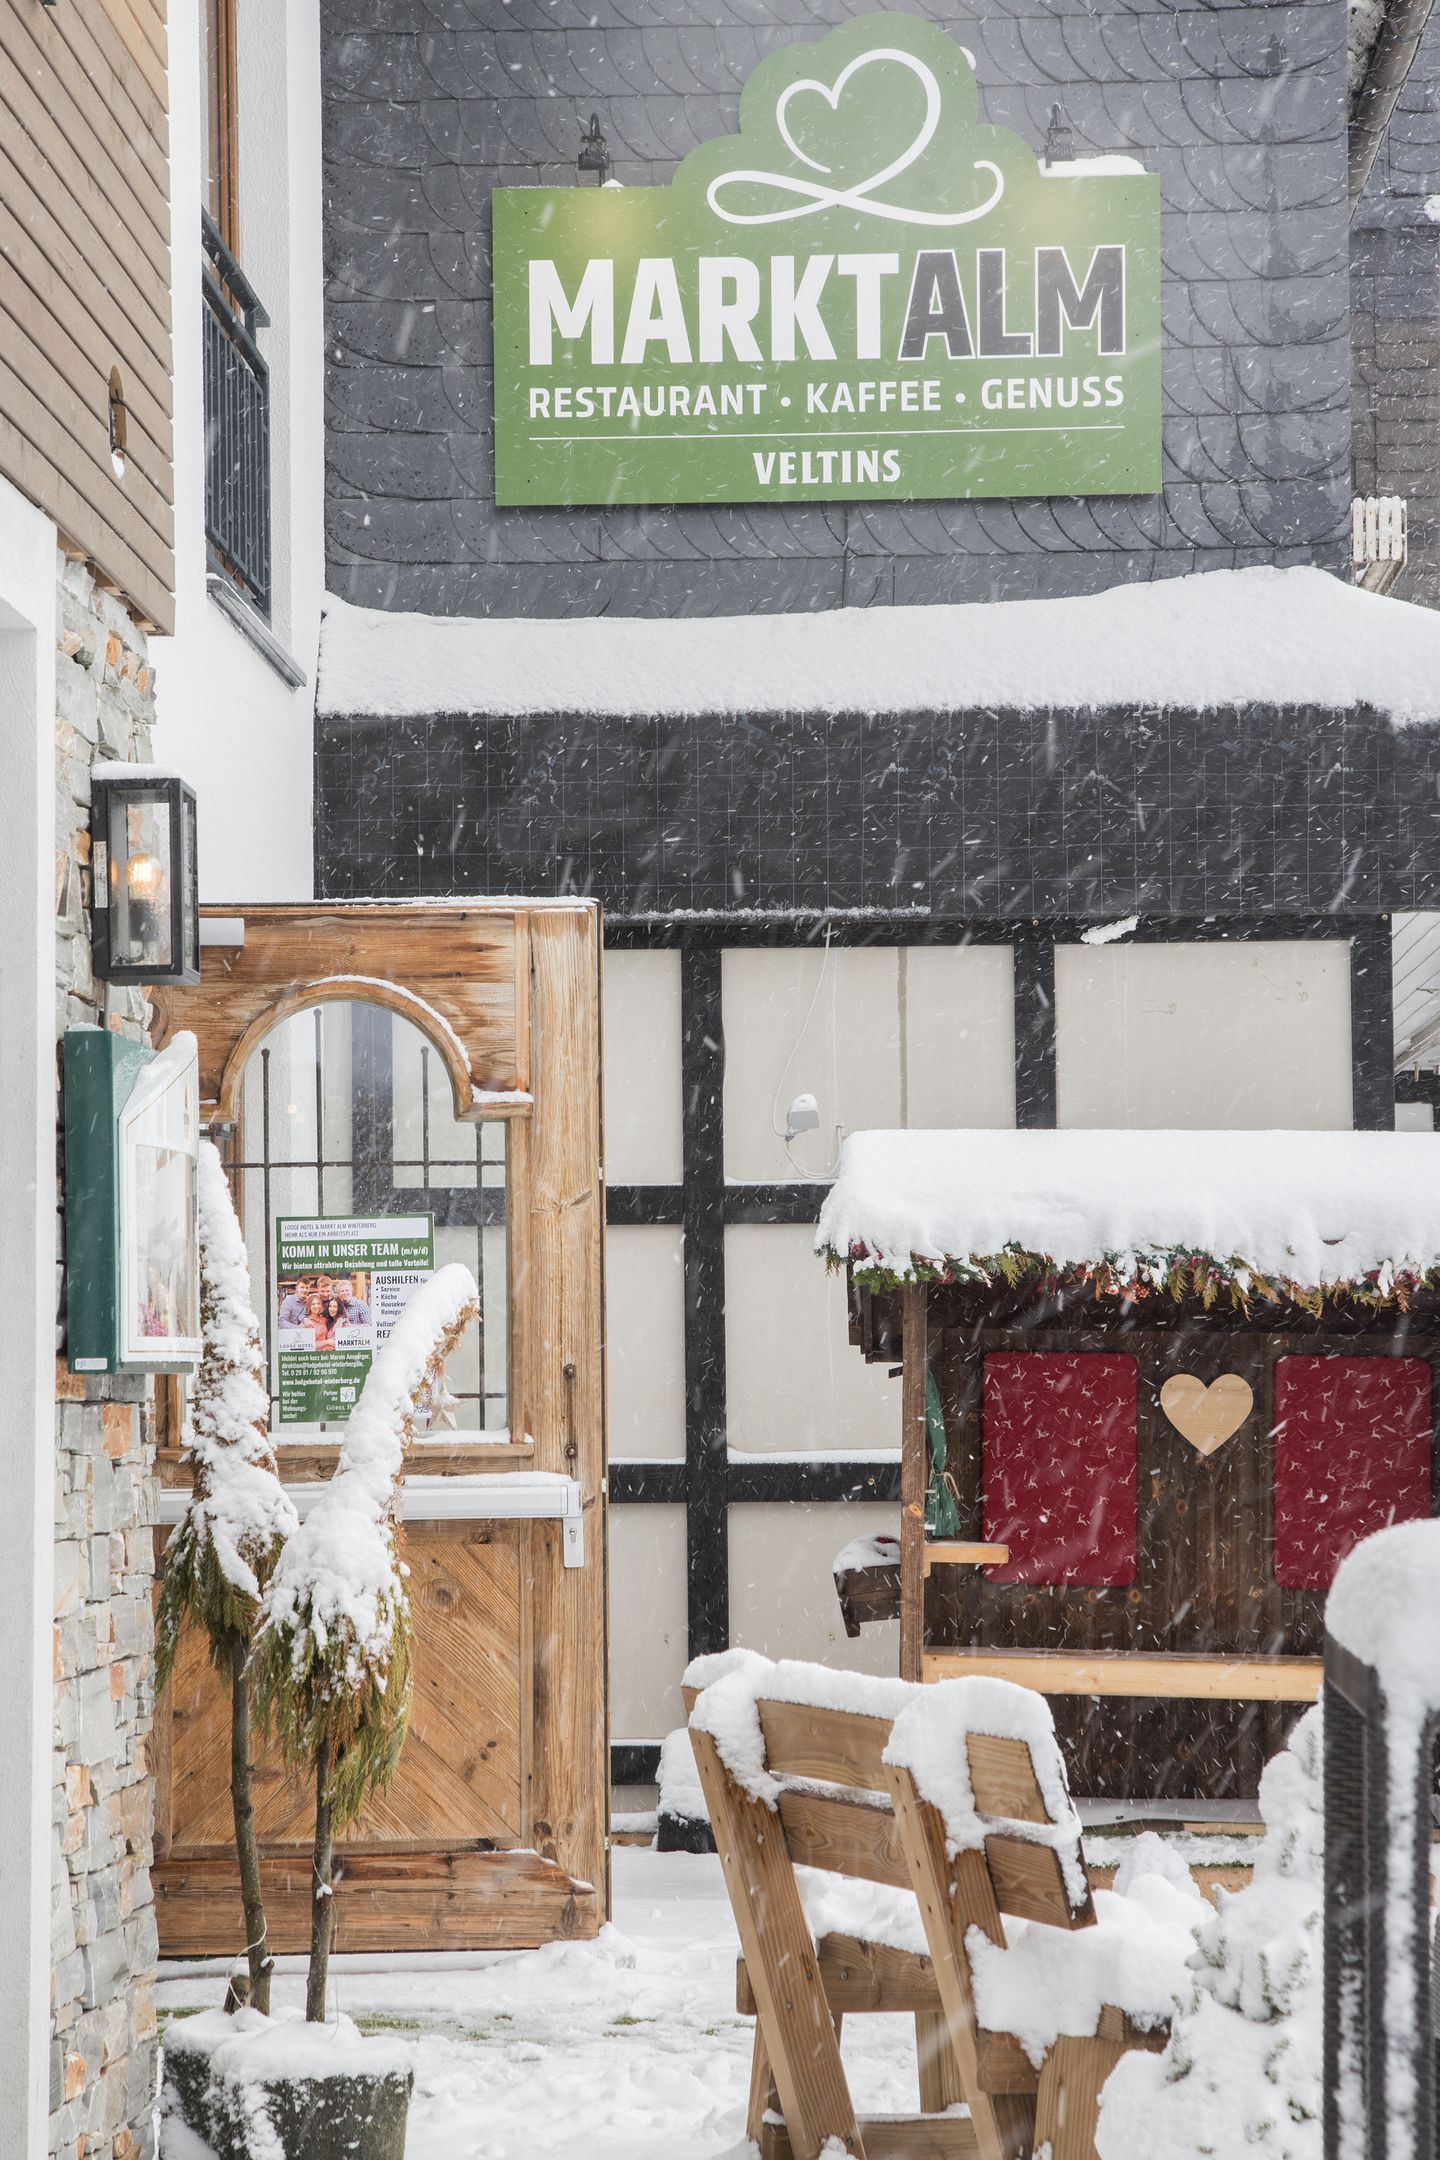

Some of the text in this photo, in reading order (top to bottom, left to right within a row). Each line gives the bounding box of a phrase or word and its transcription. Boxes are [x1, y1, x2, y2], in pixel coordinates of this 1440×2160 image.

[528, 244, 1127, 365] MARKTALM
[528, 375, 1125, 418] RESTAURANT KAFFEE GENUSS
[752, 449, 901, 484] VELTINS
[282, 1243, 428, 1258] KOMM IN UNSER TEAM (m/w/d)
[282, 1258, 429, 1270] Wir bieten attraktive Bezahlung und tolle Vorteile!
[376, 1275, 419, 1285] AUSHILFEN
[337, 1339, 370, 1347] MARKTALM
